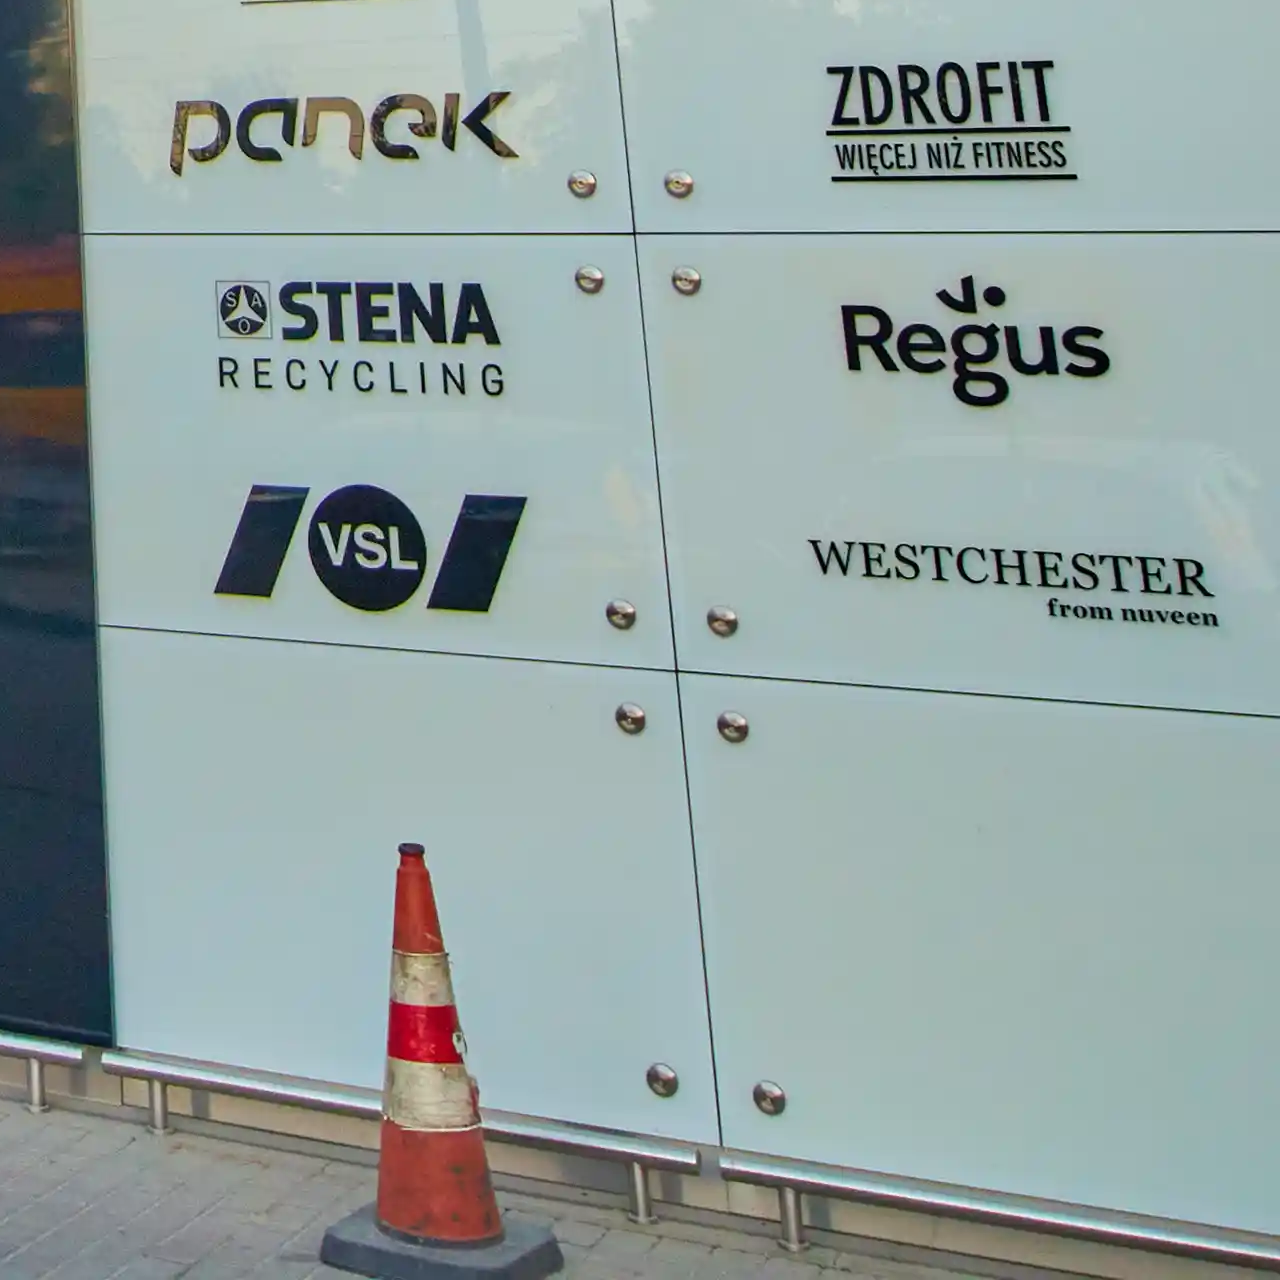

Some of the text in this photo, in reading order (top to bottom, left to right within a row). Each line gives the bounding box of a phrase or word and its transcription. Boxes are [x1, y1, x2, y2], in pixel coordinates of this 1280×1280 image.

[826, 60, 1055, 127] ZDROFIT
[169, 91, 520, 177] panek
[835, 136, 1068, 175] WIĘCEJ NIŻ FITNESS
[278, 280, 502, 345] STENA
[218, 356, 505, 397] RECYCLING
[840, 304, 1111, 407] Regus
[317, 522, 419, 571] VSL
[808, 539, 1215, 598] WESTCHESTER
[1047, 597, 1220, 628] from nuveen
